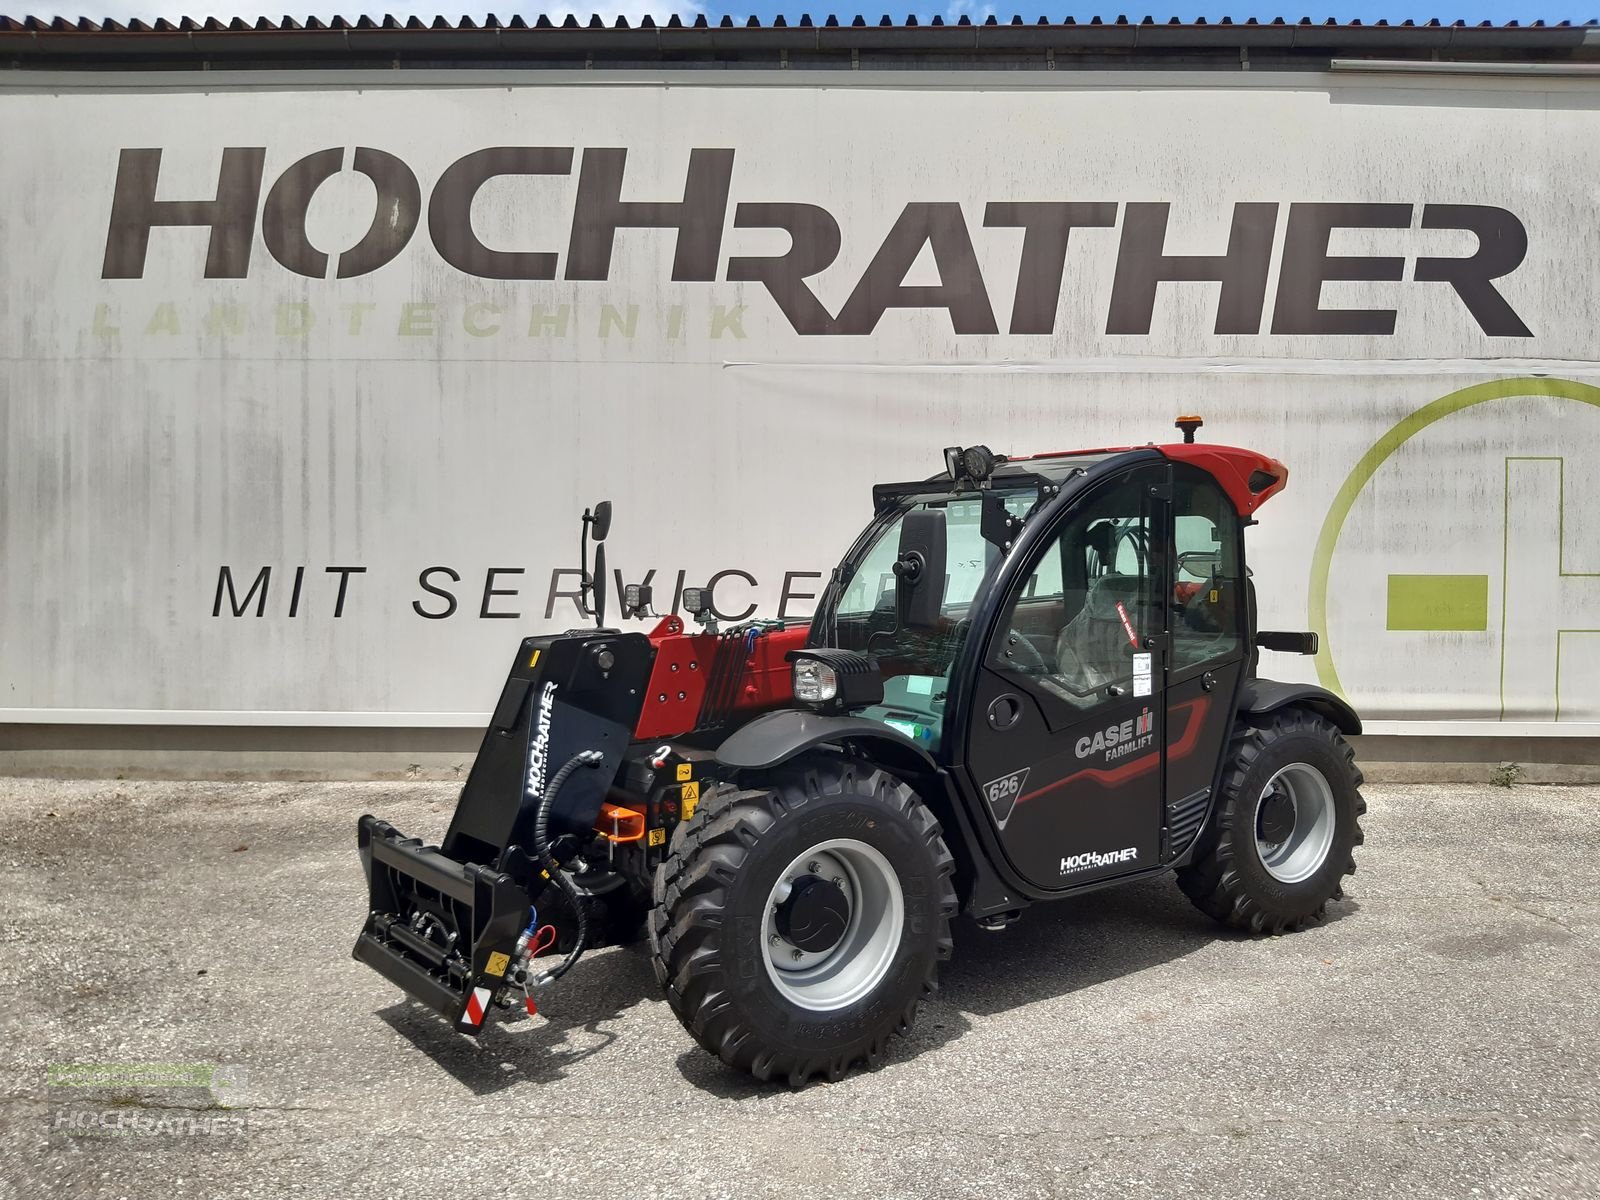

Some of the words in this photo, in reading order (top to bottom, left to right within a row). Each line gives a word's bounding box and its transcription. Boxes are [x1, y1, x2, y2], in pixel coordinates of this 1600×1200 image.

[101, 146, 1534, 338] HOCHRATHER
[91, 301, 749, 340] LANDTECHNIK
[212, 565, 367, 618] MIT
[412, 566, 823, 621] SERVICE
[527, 681, 558, 797] HOCHRATHER
[1075, 719, 1134, 759] CASE
[1105, 734, 1153, 762] FARMLIFT
[989, 775, 1018, 802] 626
[1060, 847, 1137, 871] HOCHRATHER
